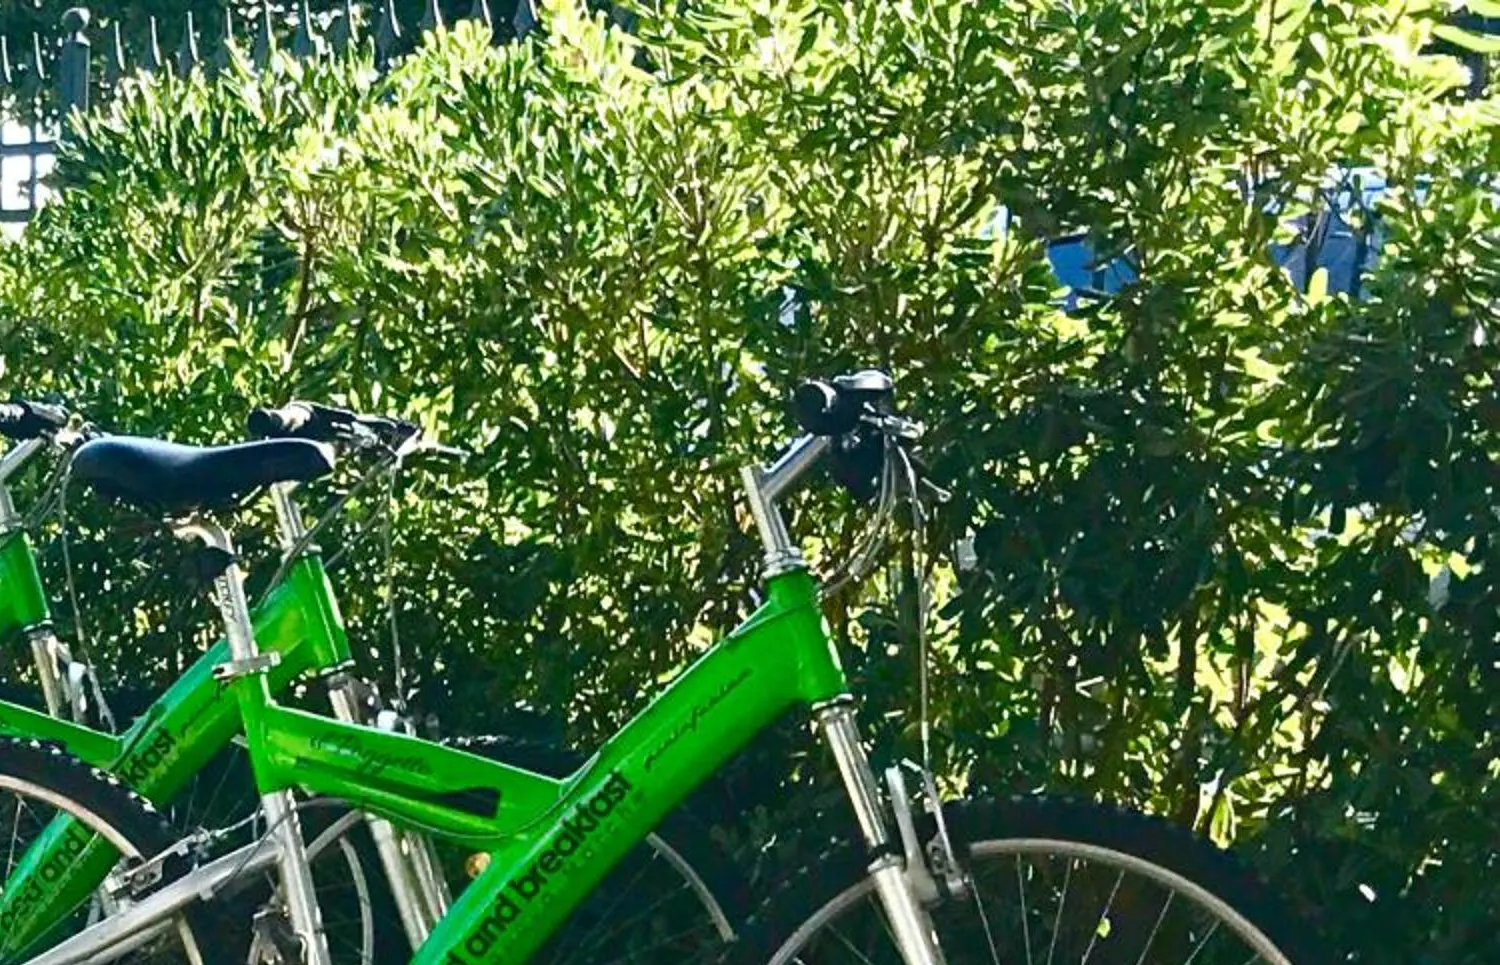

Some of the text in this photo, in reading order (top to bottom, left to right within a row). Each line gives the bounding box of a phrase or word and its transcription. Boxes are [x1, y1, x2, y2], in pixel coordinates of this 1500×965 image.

[40, 826, 88, 881] and
[114, 728, 177, 788] kfast
[466, 892, 521, 956] and
[508, 768, 633, 902] breakfast
